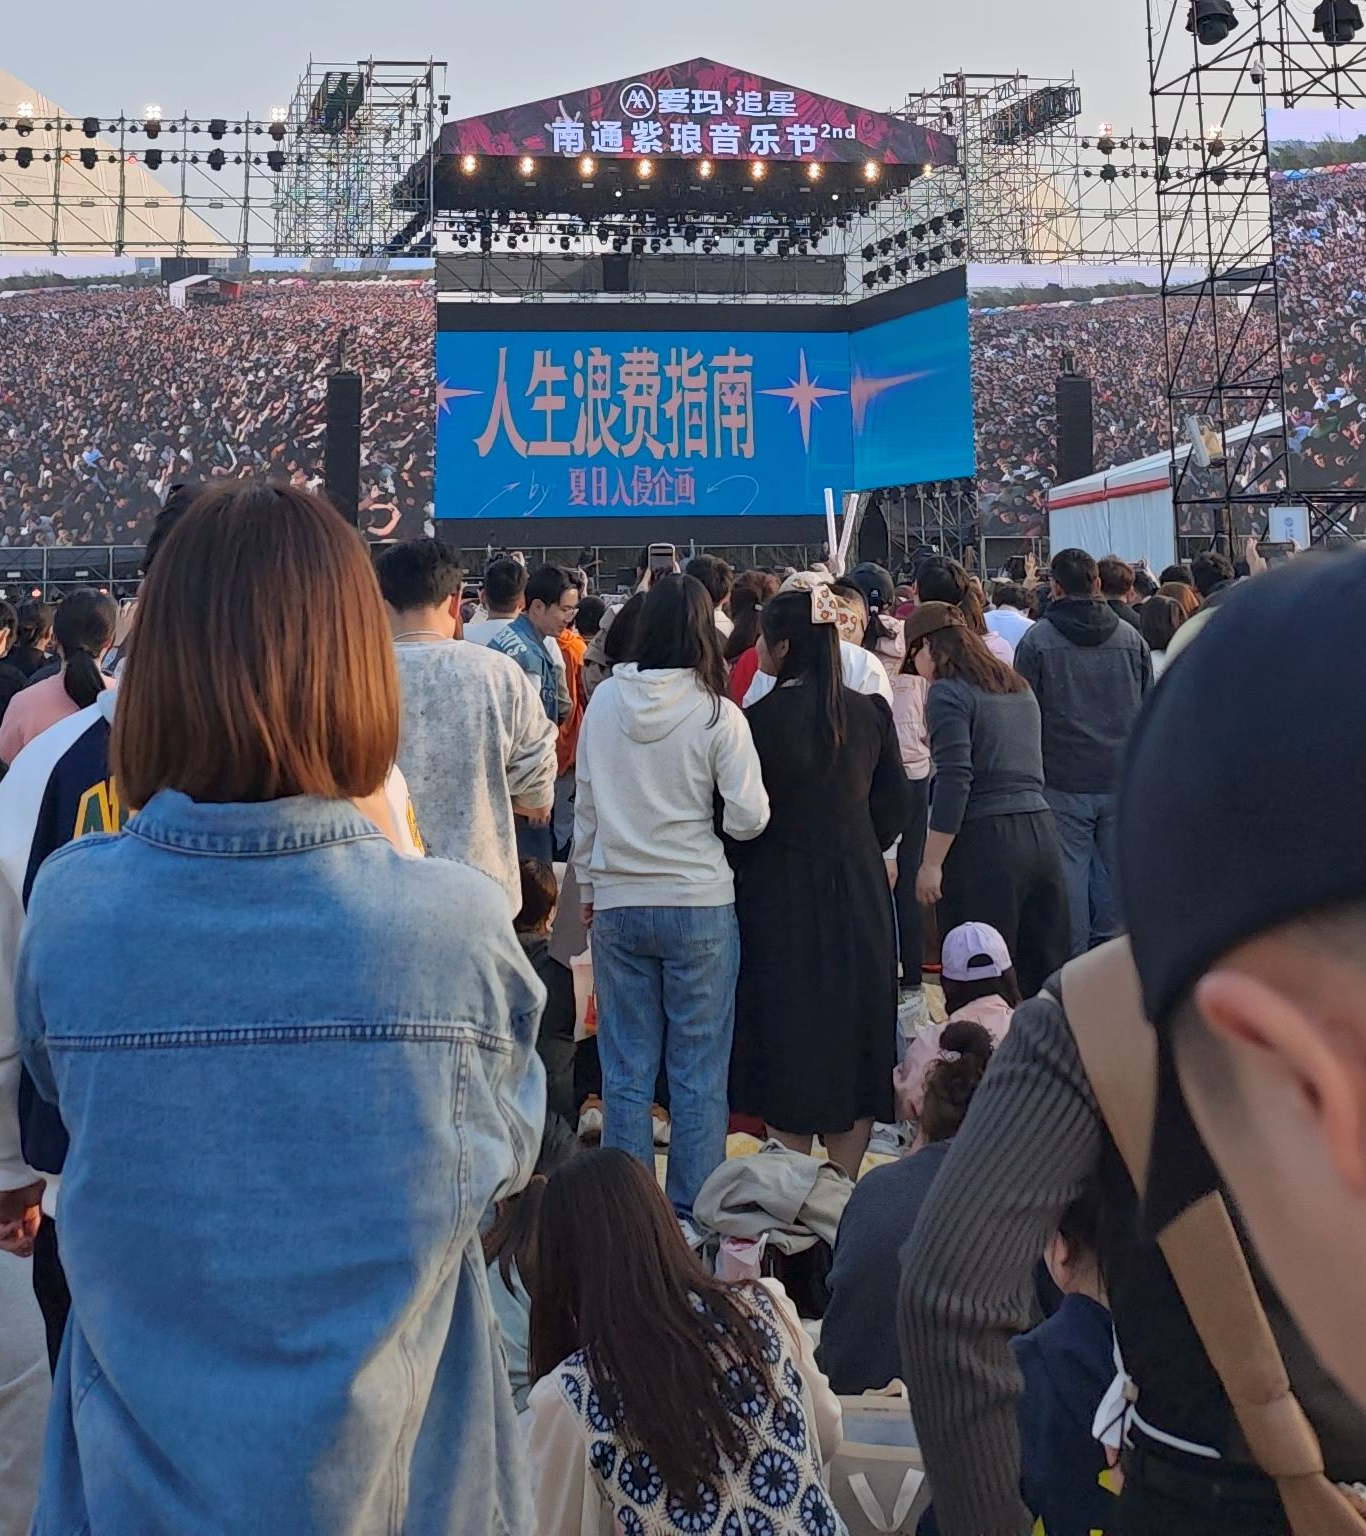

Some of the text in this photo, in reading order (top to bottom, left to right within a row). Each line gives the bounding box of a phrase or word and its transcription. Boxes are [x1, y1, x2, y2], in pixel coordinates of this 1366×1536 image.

[551, 120, 856, 156] 南通紫琅音乐节 2nd
[473, 347, 755, 459] 人生浪费指南
